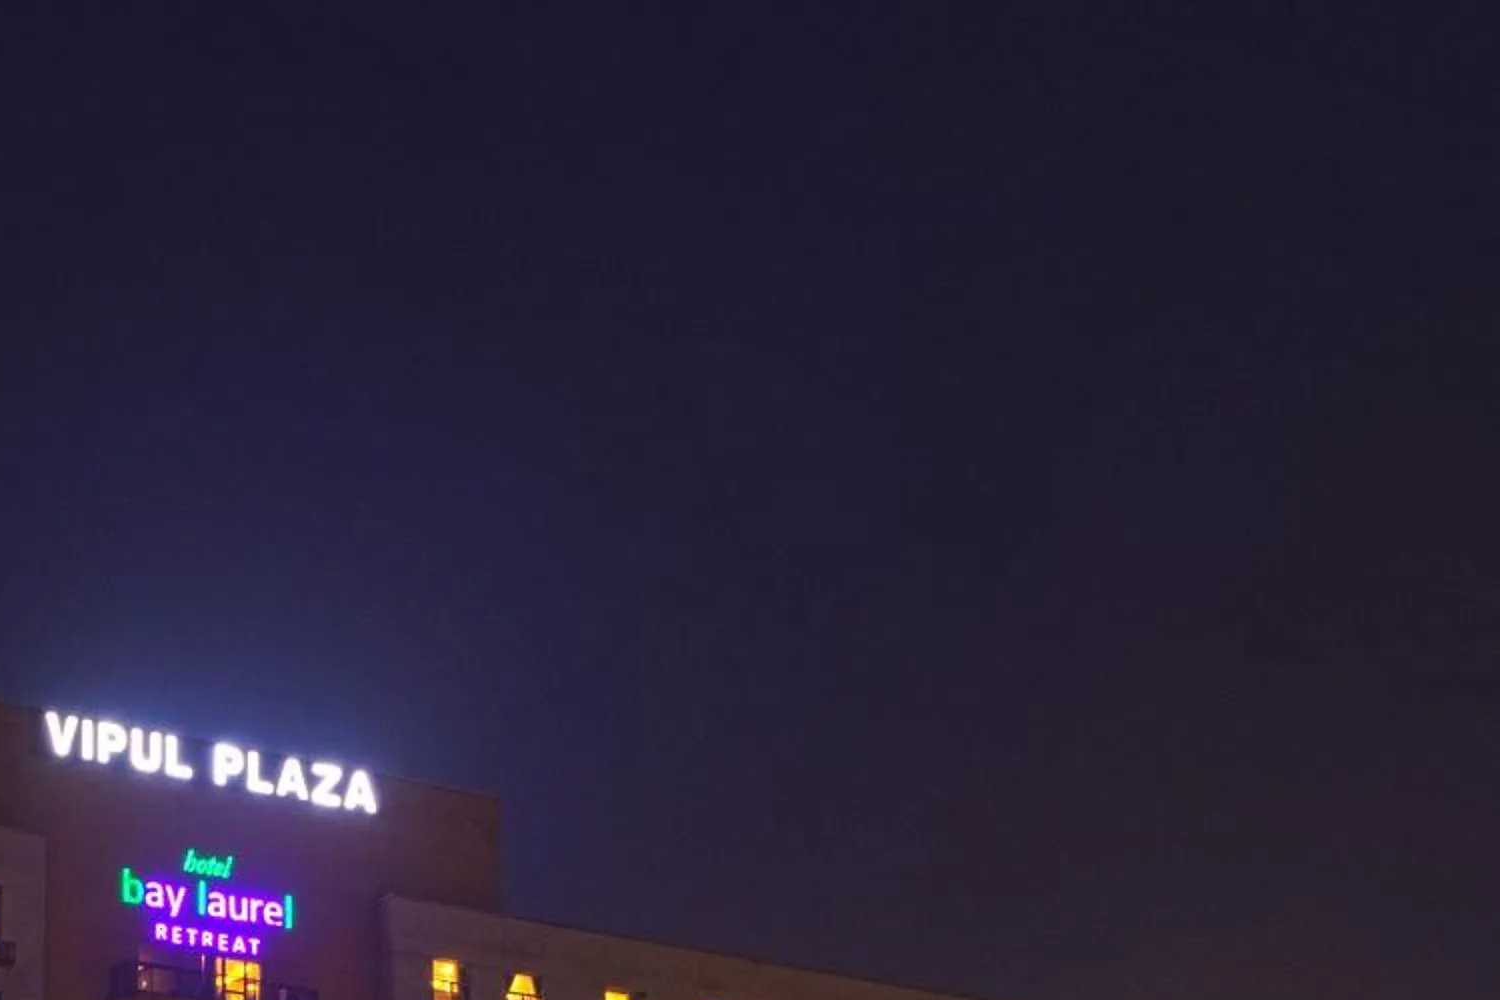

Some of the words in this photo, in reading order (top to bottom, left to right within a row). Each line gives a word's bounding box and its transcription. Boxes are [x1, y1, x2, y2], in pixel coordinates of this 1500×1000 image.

[44, 711, 193, 780] VIPUL
[212, 741, 378, 815] PLAZA
[121, 867, 186, 917] bay
[197, 880, 293, 929] laurel
[155, 924, 261, 955] RETREAT
